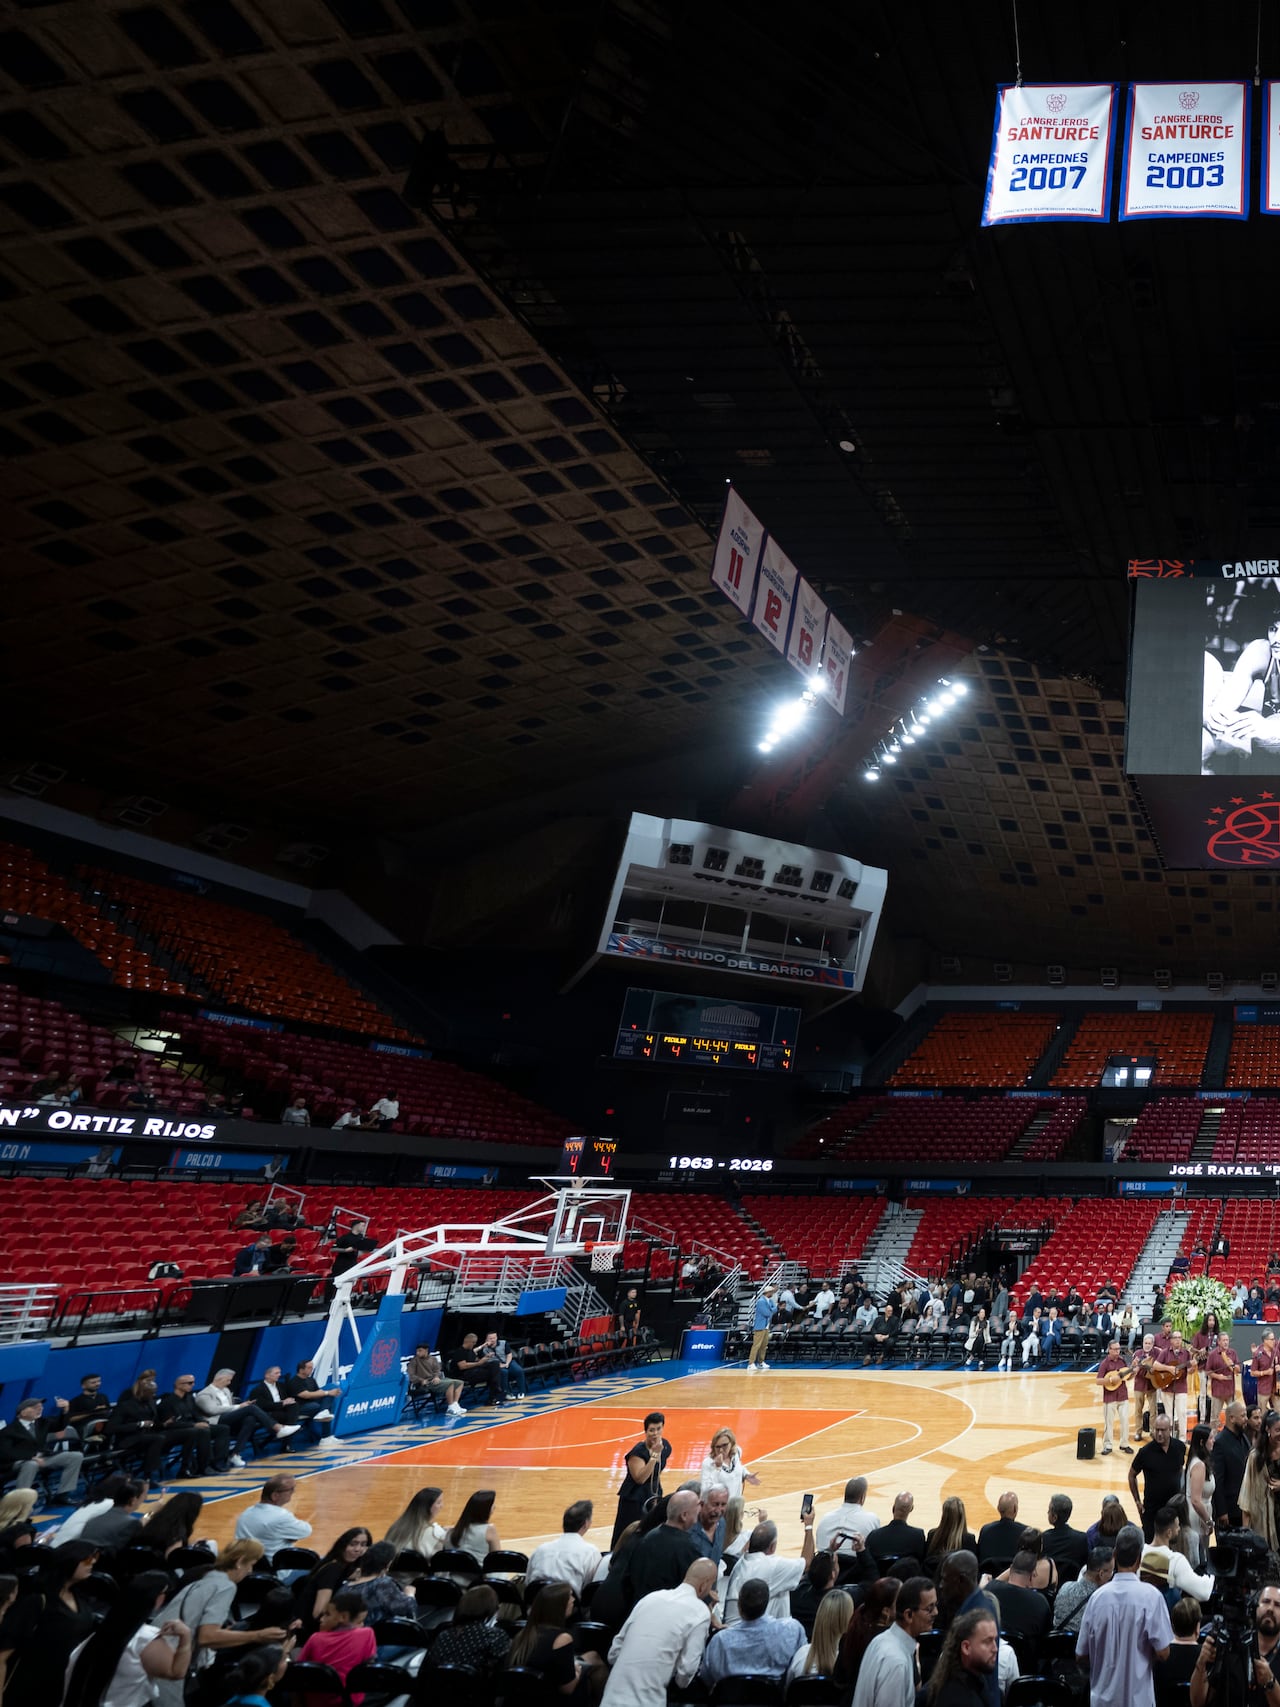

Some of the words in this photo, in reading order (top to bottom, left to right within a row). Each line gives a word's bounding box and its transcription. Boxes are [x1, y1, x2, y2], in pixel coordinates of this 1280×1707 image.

[1020, 117, 1089, 126] CANGREJEROS
[1154, 114, 1223, 124] CANGREJEROS
[1007, 126, 1100, 142] SANTURCE
[1141, 125, 1234, 141] SANTURCE
[1012, 152, 1089, 165] CAMPEONES
[1148, 152, 1225, 164] CAMPEONES
[1009, 166, 1087, 192] 2007
[1146, 164, 1225, 189] 2003
[728, 548, 744, 590] 11
[764, 588, 782, 633] 12
[798, 627, 814, 667] 13
[652, 946, 673, 957] EL
[676, 948, 727, 963] RUIDO
[728, 958, 756, 971] DEL
[758, 962, 815, 978] BARRIO
[645, 1034, 654, 1045] 4
[643, 1046, 652, 1057] 4
[671, 1046, 681, 1057] 4
[712, 1054, 721, 1064] 4
[748, 1052, 757, 1064] 4
[784, 1048, 792, 1058] 4
[782, 1060, 791, 1070] 4
[48, 1110, 137, 1135] ORTIZ
[142, 1118, 217, 1141] RIJOS
[20, 1145, 32, 1160] N
[185, 1154, 214, 1167] PALCO
[570, 1154, 579, 1173] 4
[600, 1155, 611, 1174] 4
[669, 1156, 714, 1170] 1963
[728, 1158, 774, 1171] 2026
[434, 1166, 451, 1177] PALCO
[1168, 1162, 1204, 1177] JOSÉ
[1206, 1165, 1261, 1176] RAFAEL
[1126, 1182, 1141, 1191] PALCO
[346, 1400, 369, 1415] SAN
[370, 1395, 396, 1410] JUAN
